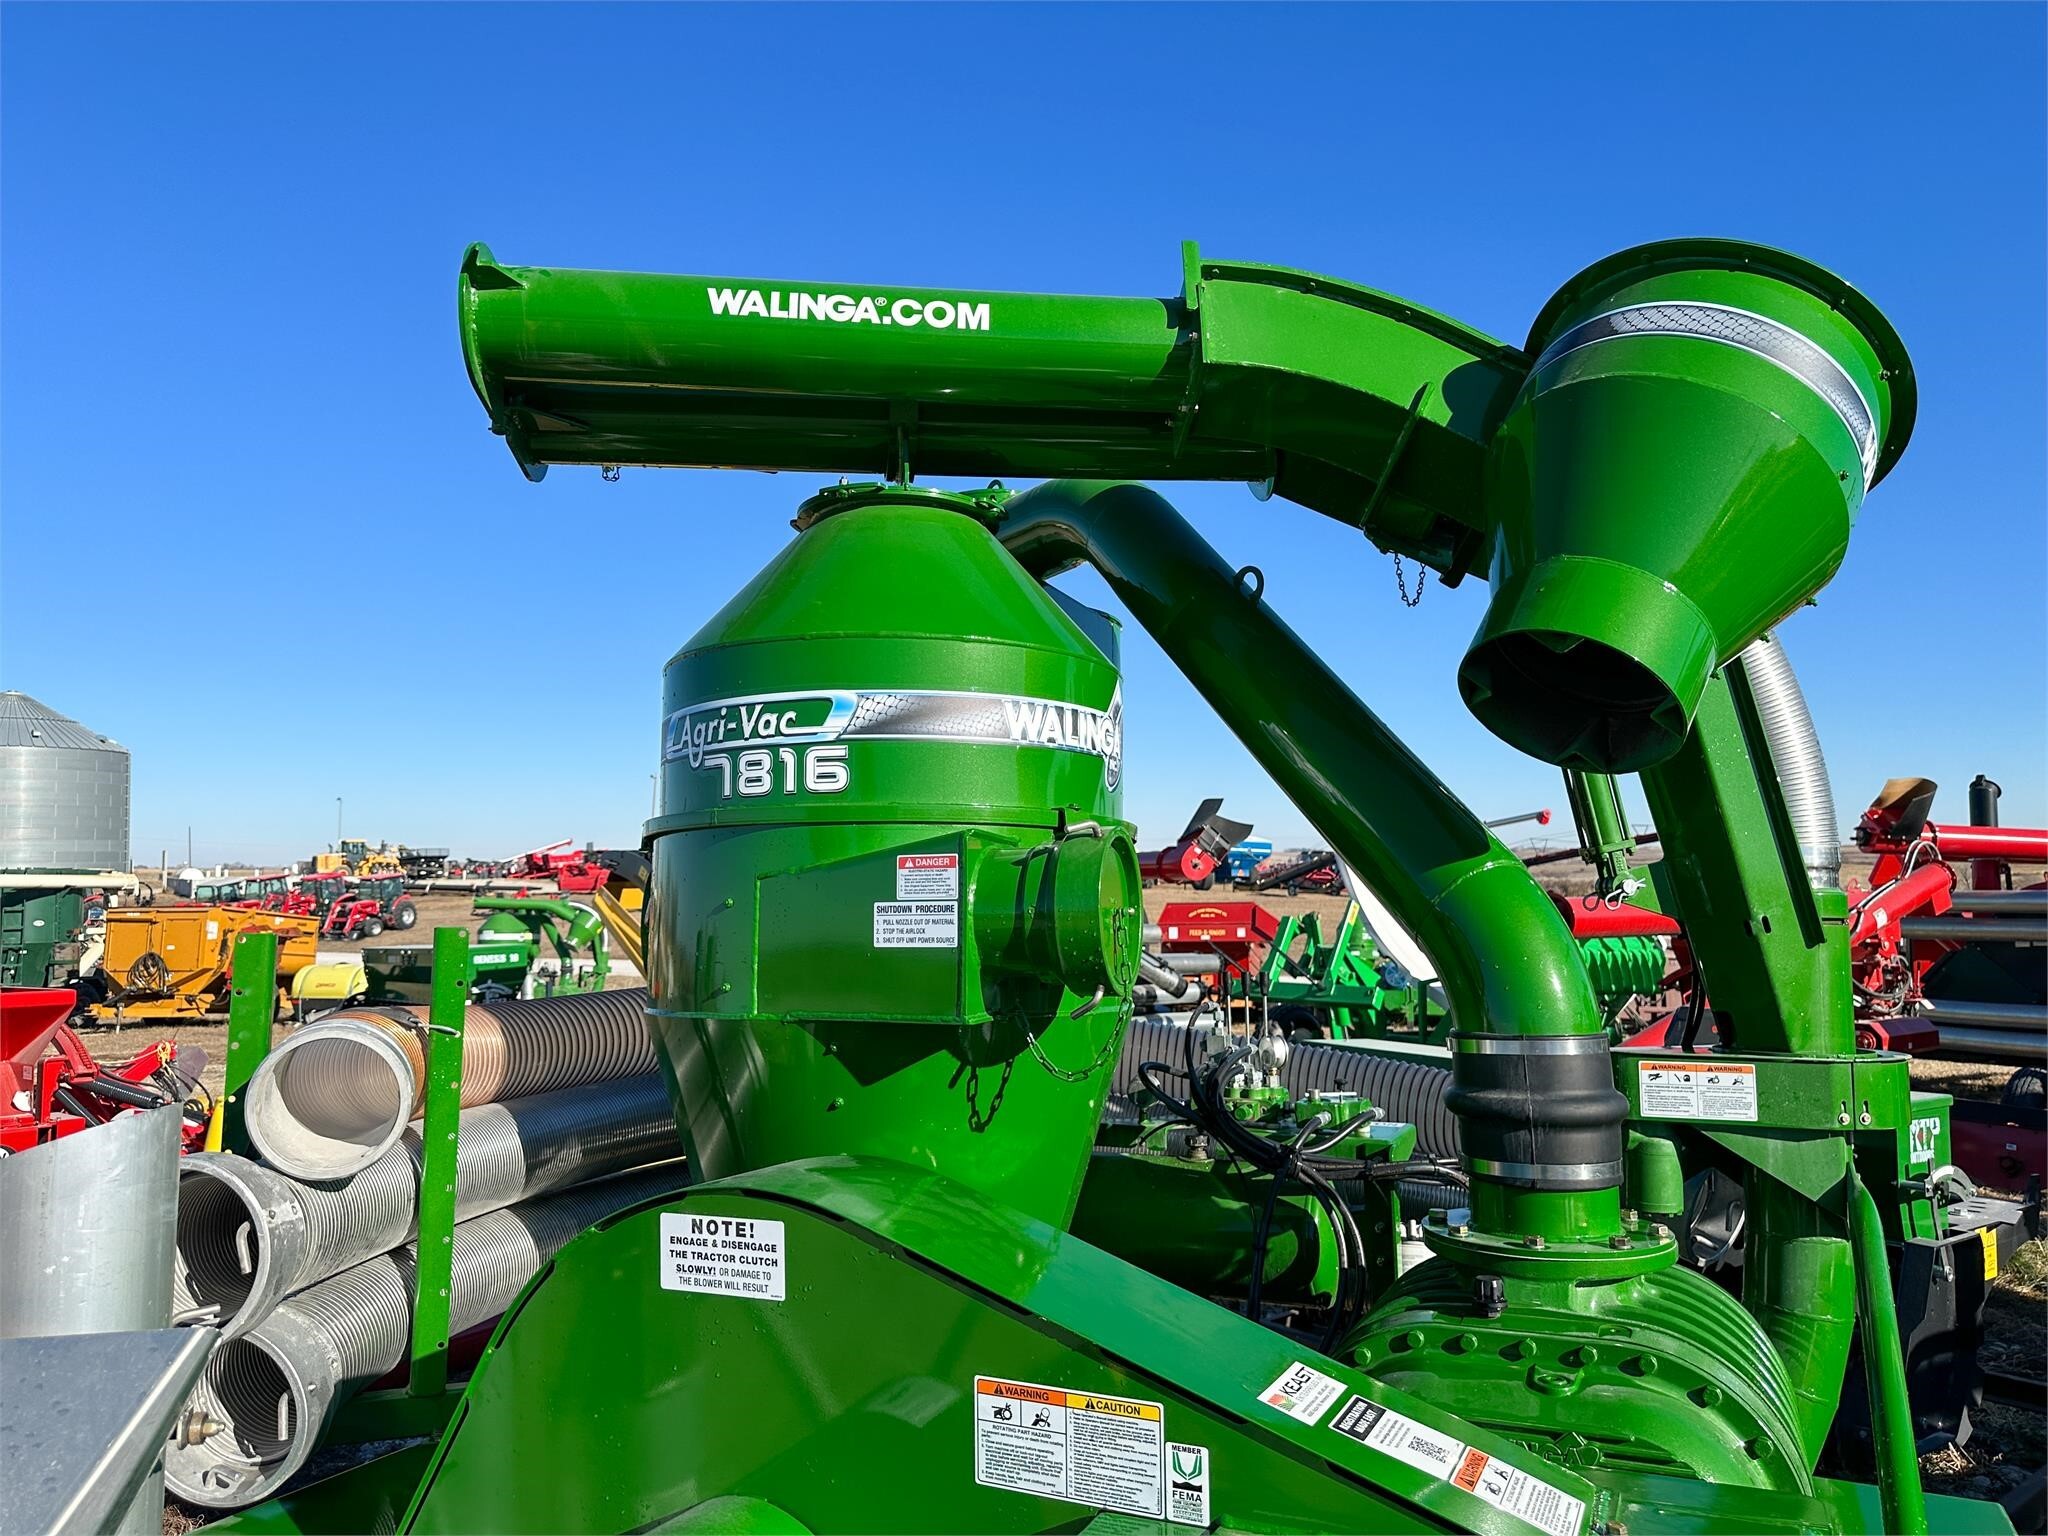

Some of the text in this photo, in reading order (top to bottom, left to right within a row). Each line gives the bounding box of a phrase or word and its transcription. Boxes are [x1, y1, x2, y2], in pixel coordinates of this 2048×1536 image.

[680, 704, 797, 768] Agri-Vac
[1003, 699, 1121, 756] WALINGA
[703, 745, 850, 799] 7816
[915, 858, 950, 866] DANGER
[876, 904, 955, 913] SHUTDOWN PROCEDURE
[691, 1218, 755, 1239] NOTE!
[670, 1236, 777, 1253] ENGAGE & DISENGAGE
[669, 1250, 778, 1267] THE TRACTOR CLUTCH
[676, 1264, 771, 1280] SLOWLY! OR DAMAGE TO
[679, 1276, 768, 1293] THE BLOWER WILL RESULT
[1279, 1366, 1314, 1397] KEAST
[1004, 1386, 1049, 1401] WARNING
[1096, 1401, 1141, 1416] CAUTION
[992, 1424, 1017, 1434] ROTATING
[1031, 1430, 1052, 1439] HAZARD
[1172, 1445, 1201, 1455] MEMBER
[1462, 1453, 1484, 1479] WARNING
[1172, 1490, 1202, 1502] FEMA
